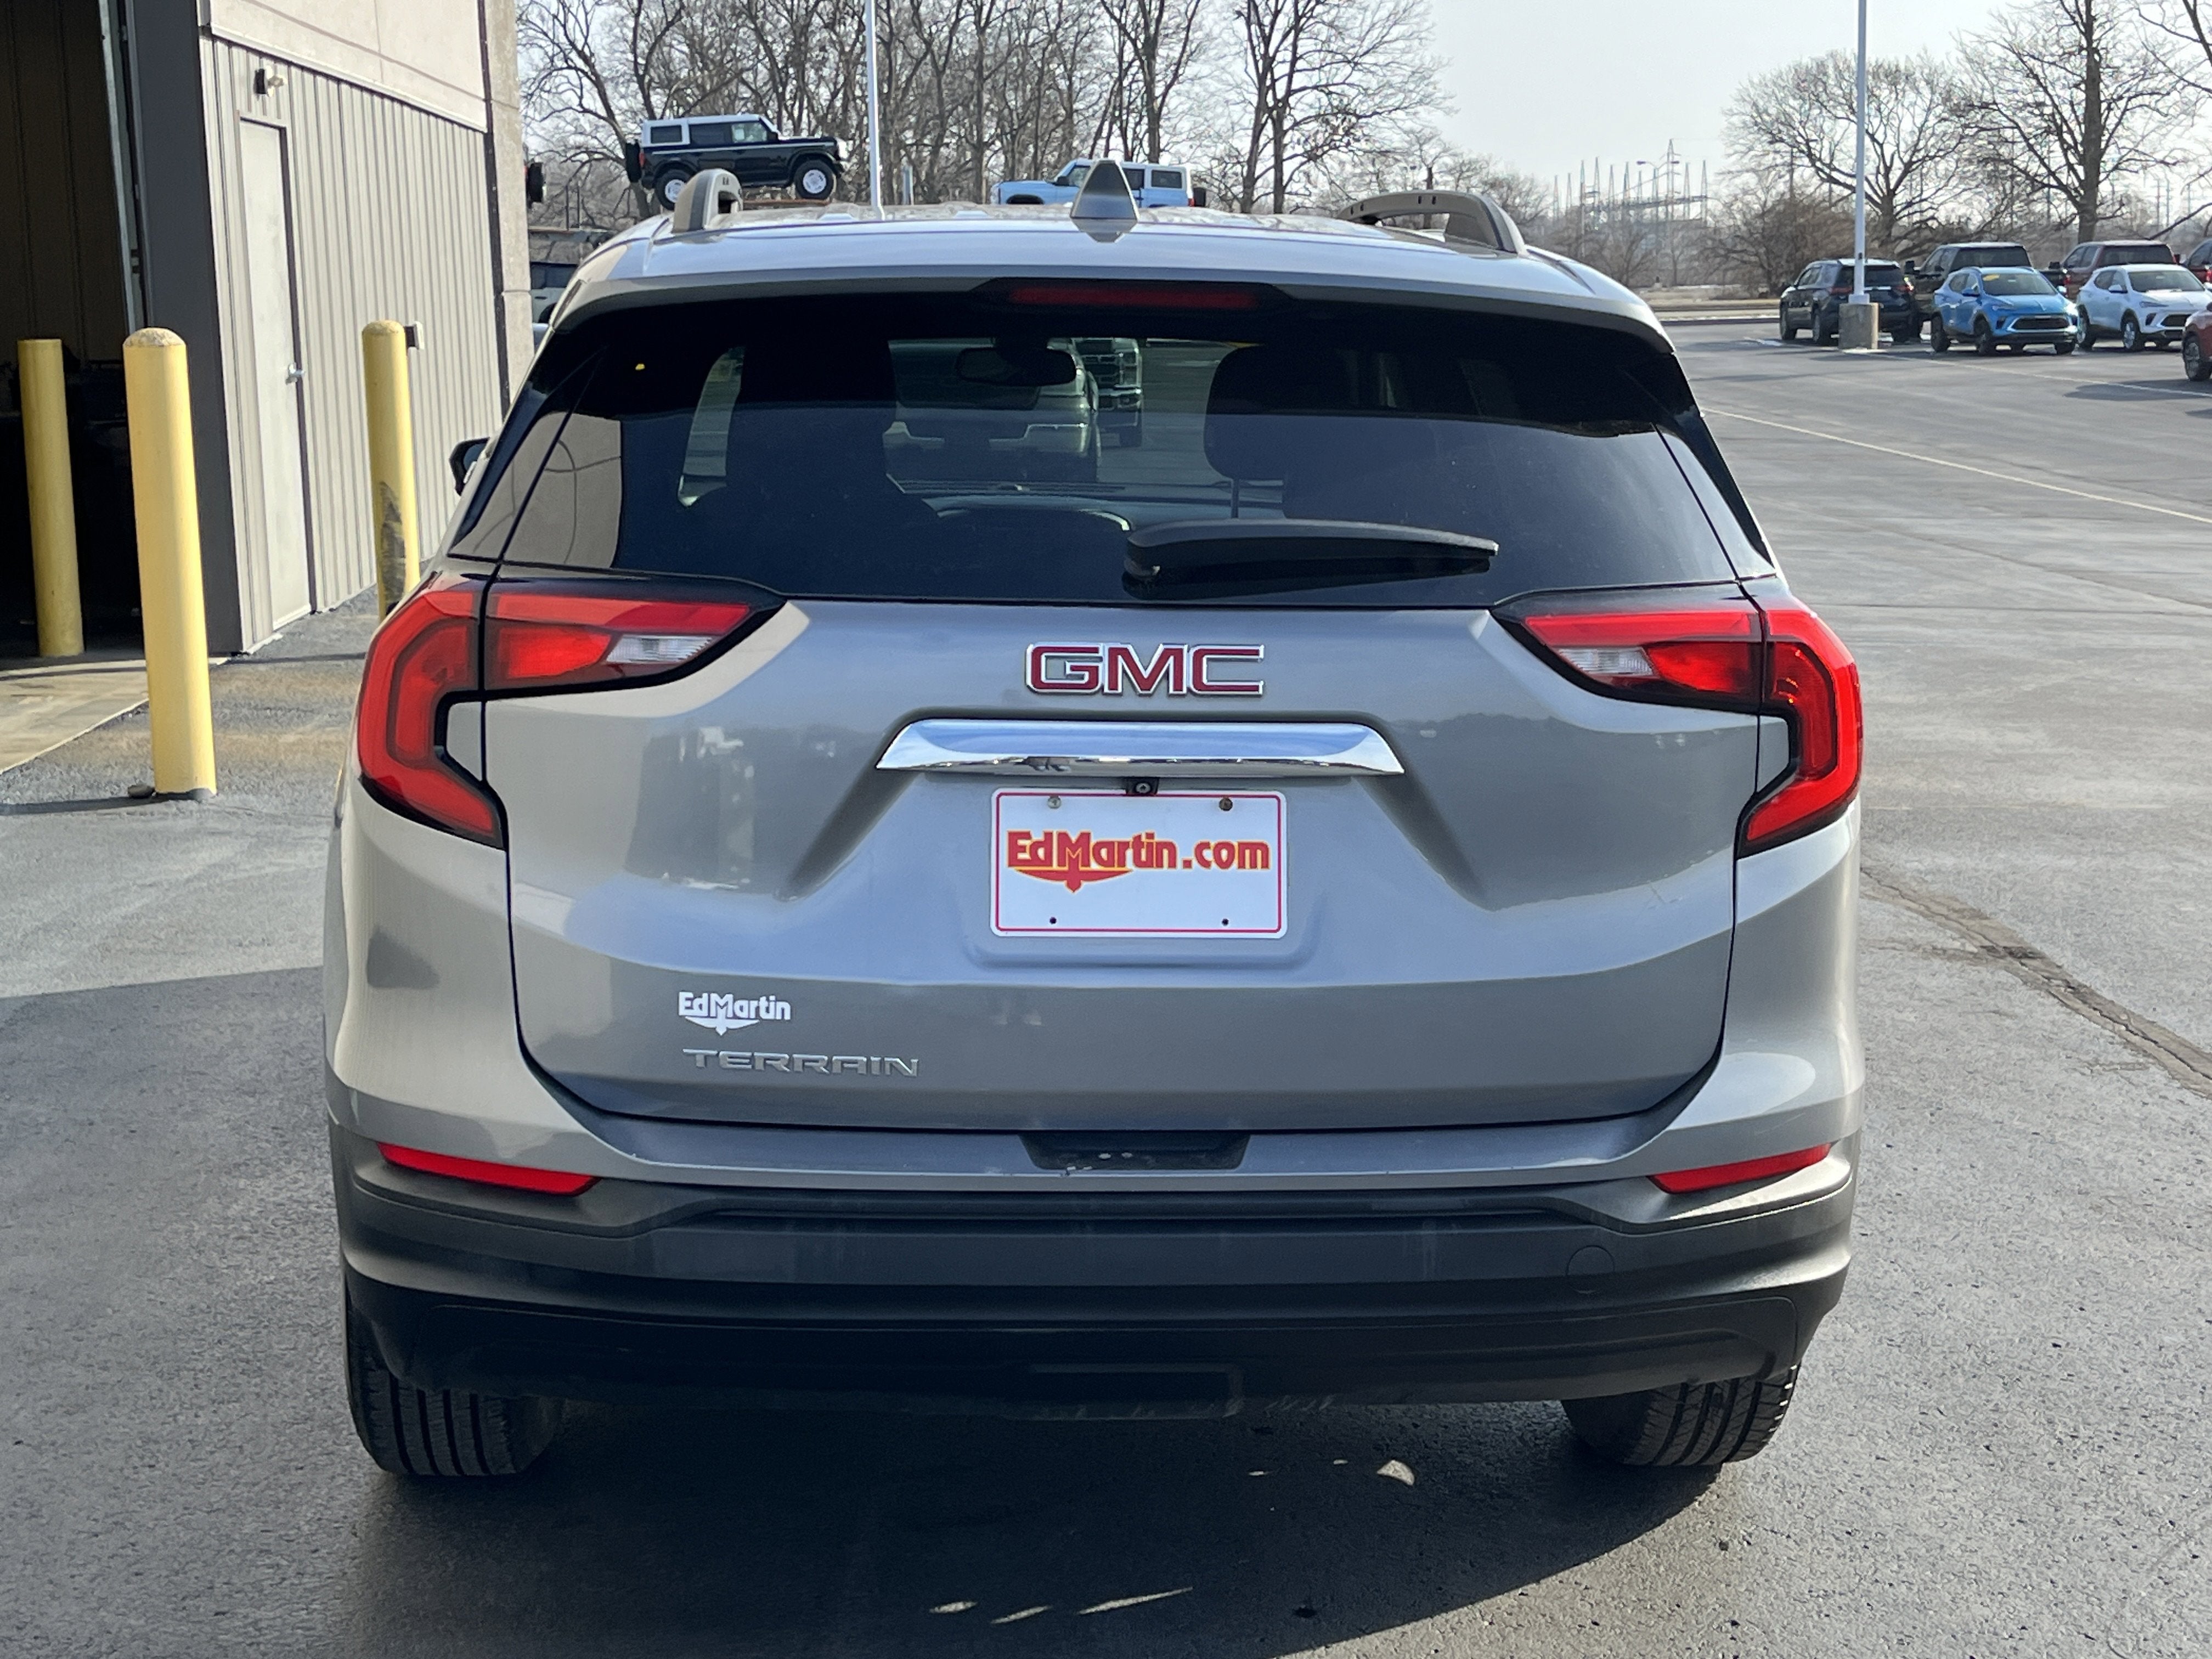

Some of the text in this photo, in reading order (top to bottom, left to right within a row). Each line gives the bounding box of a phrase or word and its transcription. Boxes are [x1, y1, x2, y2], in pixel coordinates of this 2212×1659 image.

[1026, 642, 1265, 696] GMC
[1006, 830, 1271, 871] EdMartin.com
[682, 1048, 920, 1077] TERRAIN
